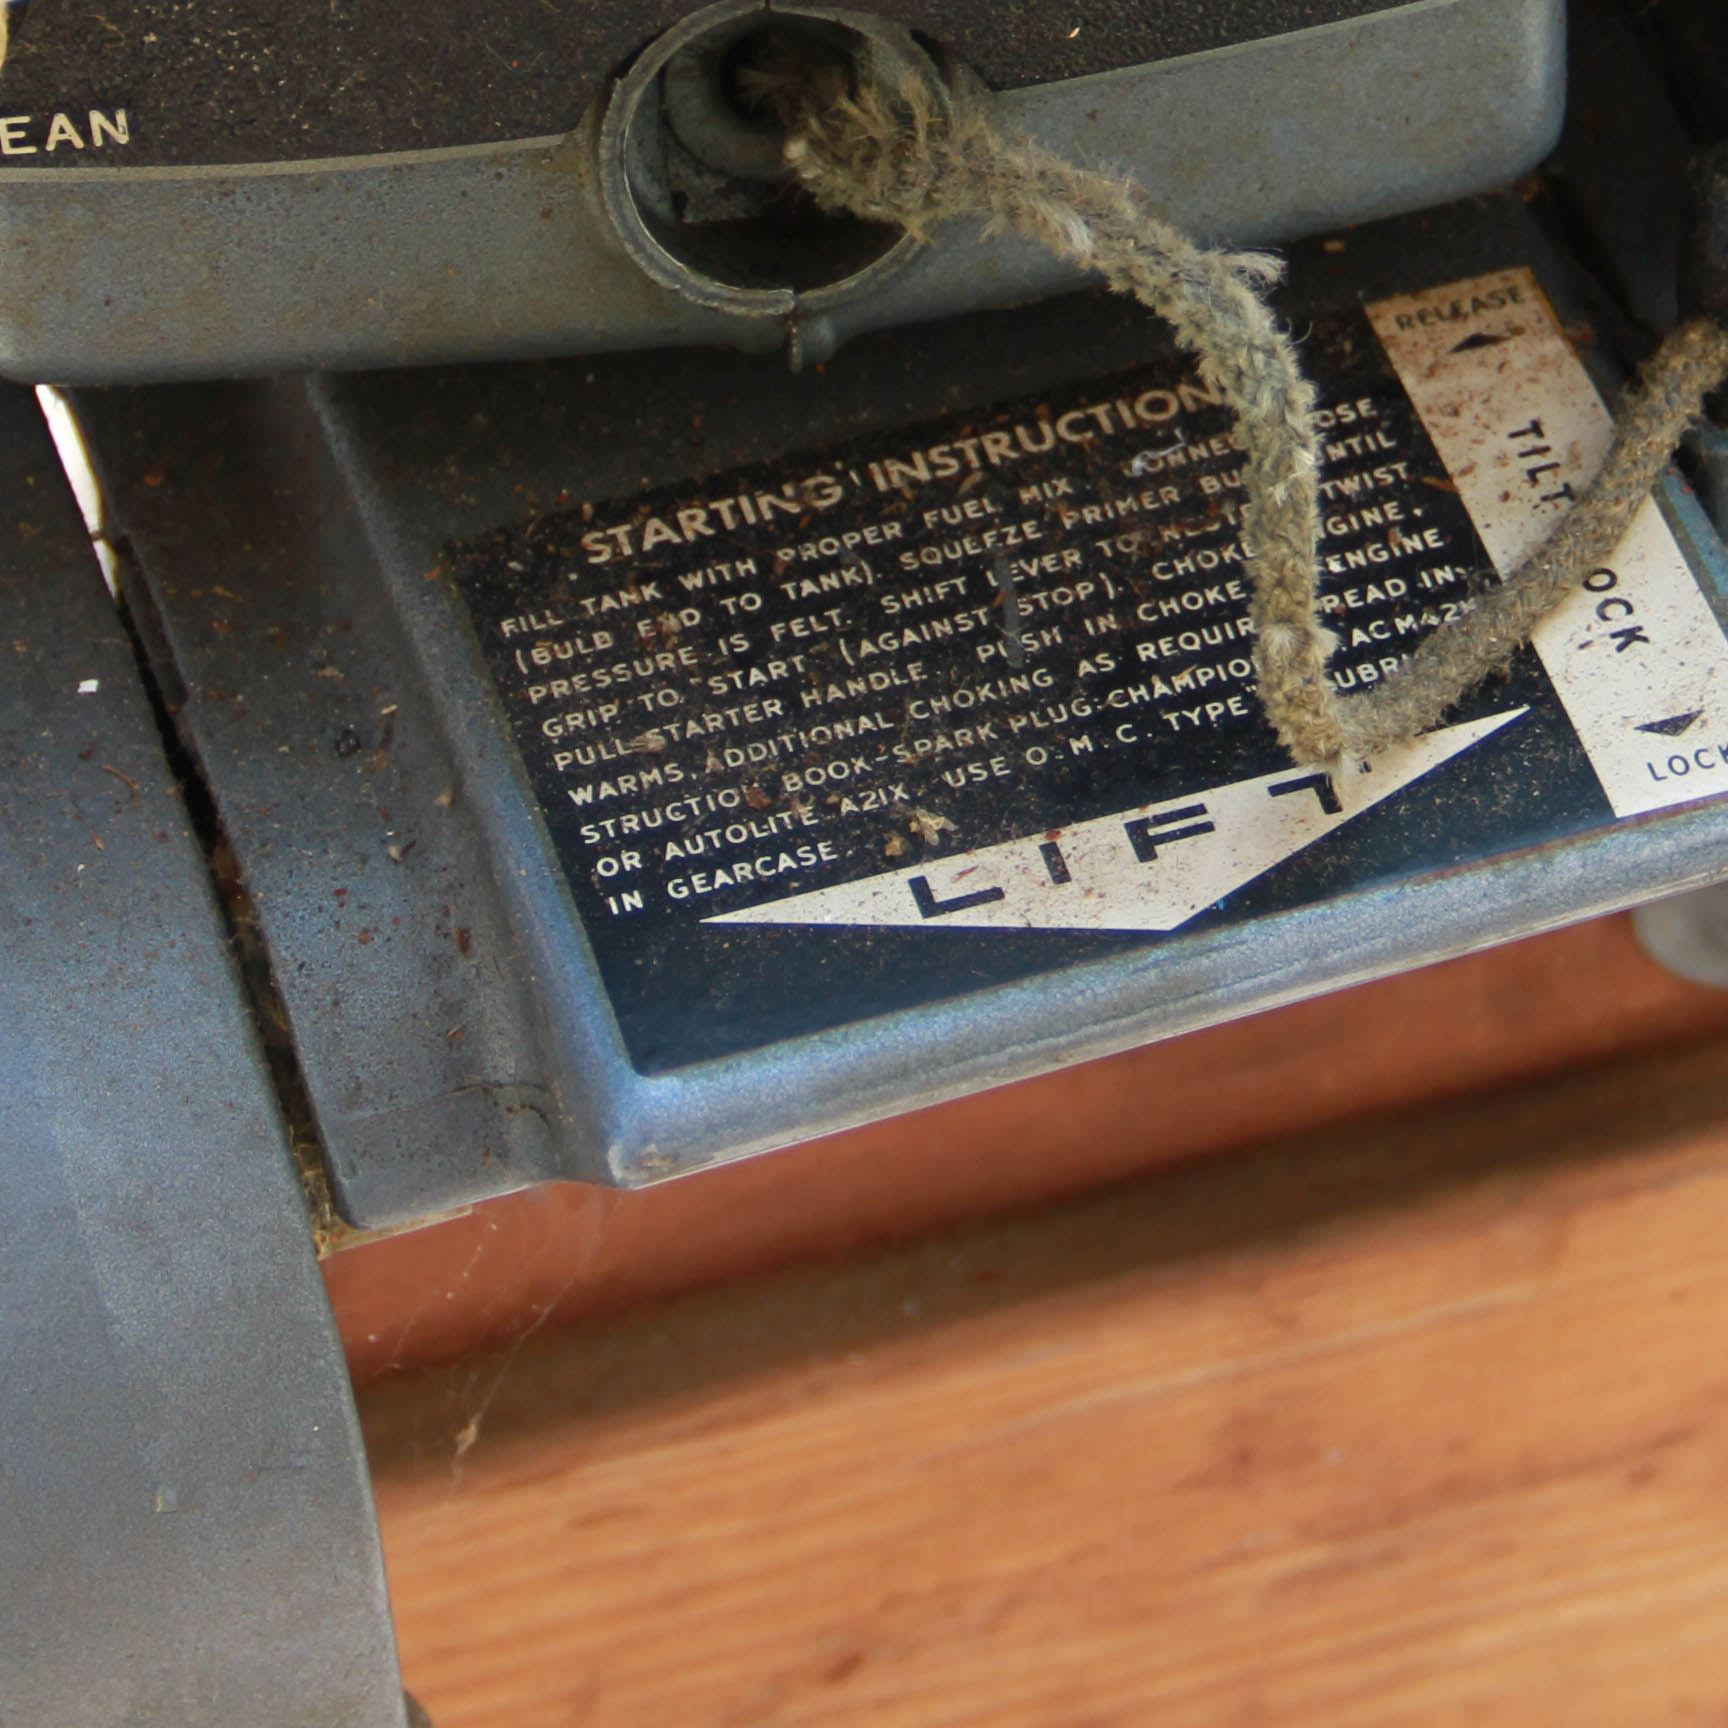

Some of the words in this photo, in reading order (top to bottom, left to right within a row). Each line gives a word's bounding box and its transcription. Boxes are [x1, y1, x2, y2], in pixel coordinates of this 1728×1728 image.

[1395, 286, 1528, 333] RELEASE
[500, 608, 564, 638] FILL
[579, 580, 664, 616] TANK
[677, 557, 758, 592] WITH
[776, 519, 904, 563] PROPER
[922, 495, 1001, 530] FUEL
[1312, 396, 1379, 429] OSE
[515, 629, 615, 675] (BULB
[636, 606, 702, 639] ED
[719, 592, 763, 616] TO
[1059, 484, 1182, 531] PRIMER
[1318, 430, 1398, 463] NTIL
[580, 474, 844, 565] STARTING
[868, 379, 1228, 493] INSTRUCTION
[1507, 418, 1577, 506] TILT
[1581, 566, 1651, 655] OCK
[527, 645, 700, 706] PRESSURE
[718, 632, 751, 657] IS
[770, 606, 854, 643] FELT.
[879, 575, 969, 615] SHIFT
[1095, 533, 1141, 559] TO
[1321, 461, 1409, 500] TWIST
[541, 703, 619, 739] GRIP
[637, 687, 680, 712] TO
[837, 606, 991, 668] (AGAINST
[552, 738, 633, 772] PULL
[1083, 613, 1118, 637] IN
[1136, 579, 1247, 623] CHOKE
[1324, 527, 1445, 574] ENGINE
[908, 667, 1055, 721] CHOKING
[1078, 653, 1117, 678] AS
[1135, 616, 1258, 663] REQUIR
[1320, 577, 1407, 615] READ
[578, 784, 756, 846] STRUCTIO
[595, 849, 643, 878] OR
[663, 805, 821, 862] AUTOLITE
[944, 756, 1012, 789] USE
[1162, 695, 1249, 733] TYPE
[907, 761, 1372, 919] LIFT
[606, 889, 645, 916] IN
